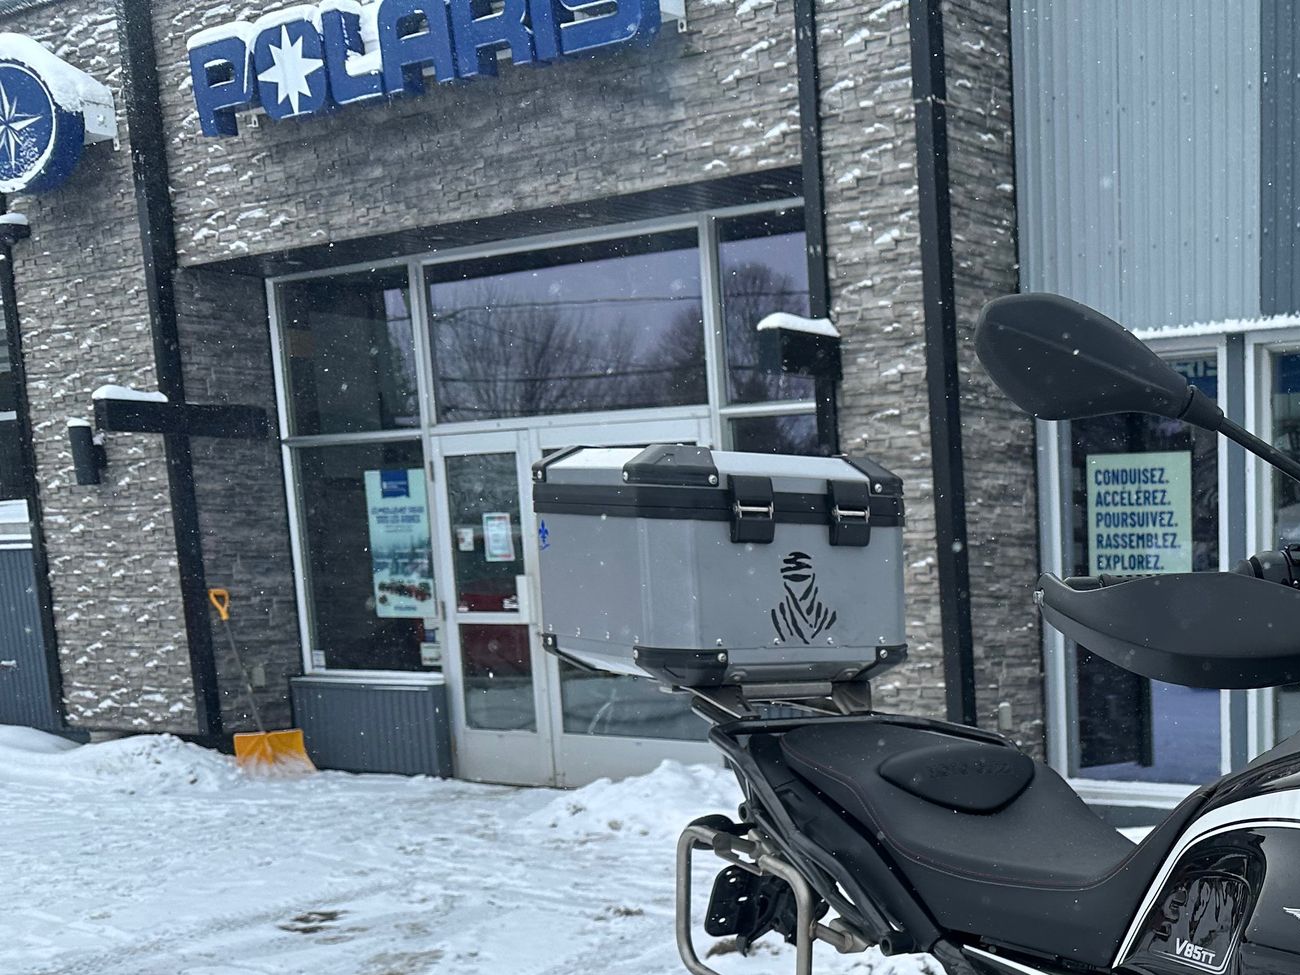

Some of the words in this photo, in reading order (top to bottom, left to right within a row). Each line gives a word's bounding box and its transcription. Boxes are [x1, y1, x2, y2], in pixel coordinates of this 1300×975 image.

[187, 0, 658, 137] POLARIS
[1095, 468, 1170, 485] CONDUISEZ.
[1096, 511, 1178, 528] POURSUIVEZ.
[1097, 533, 1181, 549] RASSEMBLEZ.
[1097, 555, 1164, 570] EXPLOREZ.
[1176, 938, 1216, 964] V85TT
